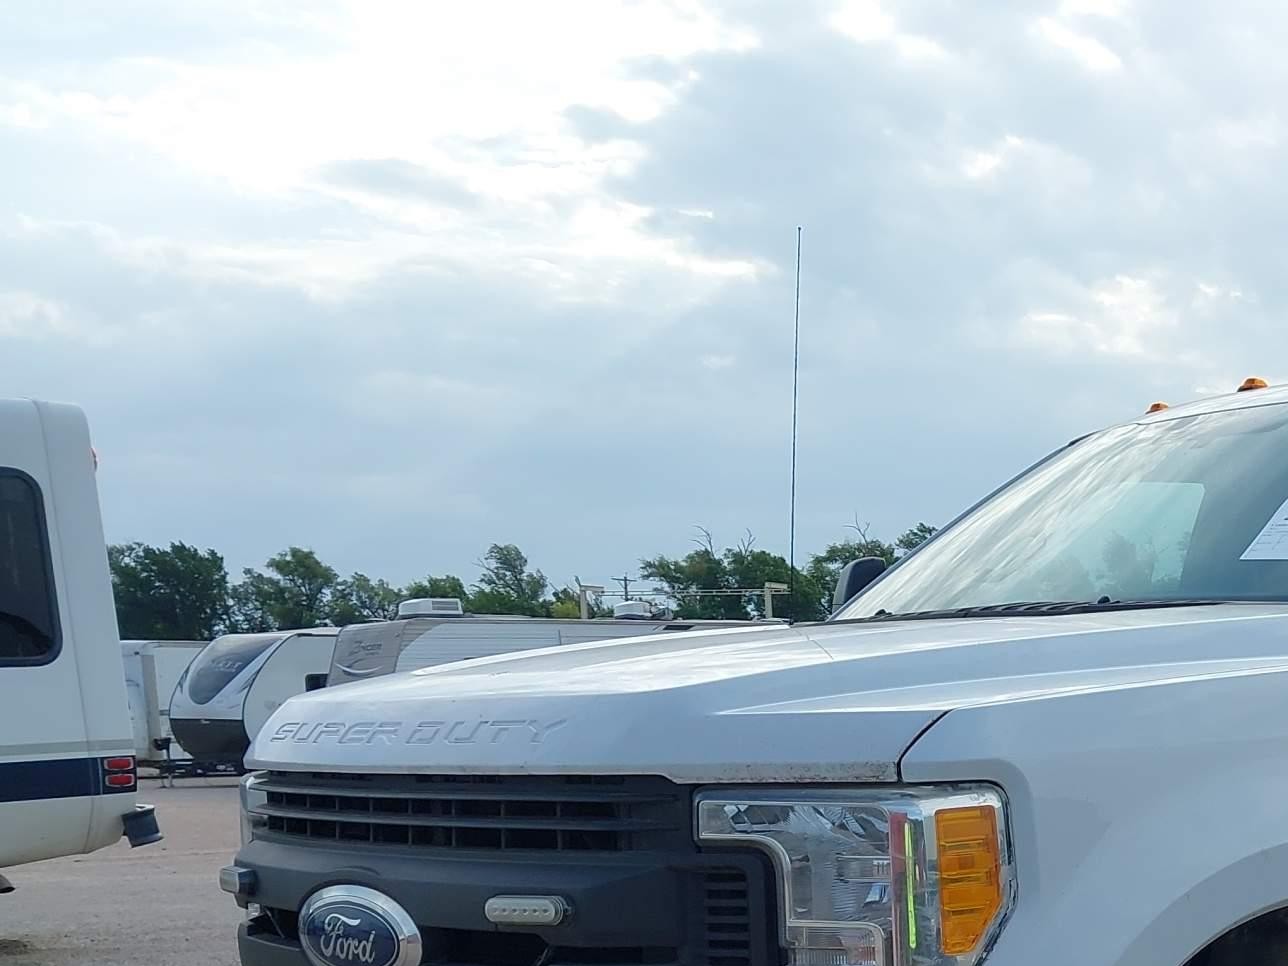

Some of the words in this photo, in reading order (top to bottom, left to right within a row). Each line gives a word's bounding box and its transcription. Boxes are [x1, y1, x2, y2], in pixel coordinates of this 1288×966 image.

[270, 719, 403, 745] SUPER
[404, 718, 568, 745] DUTY
[319, 913, 377, 963] Ford
